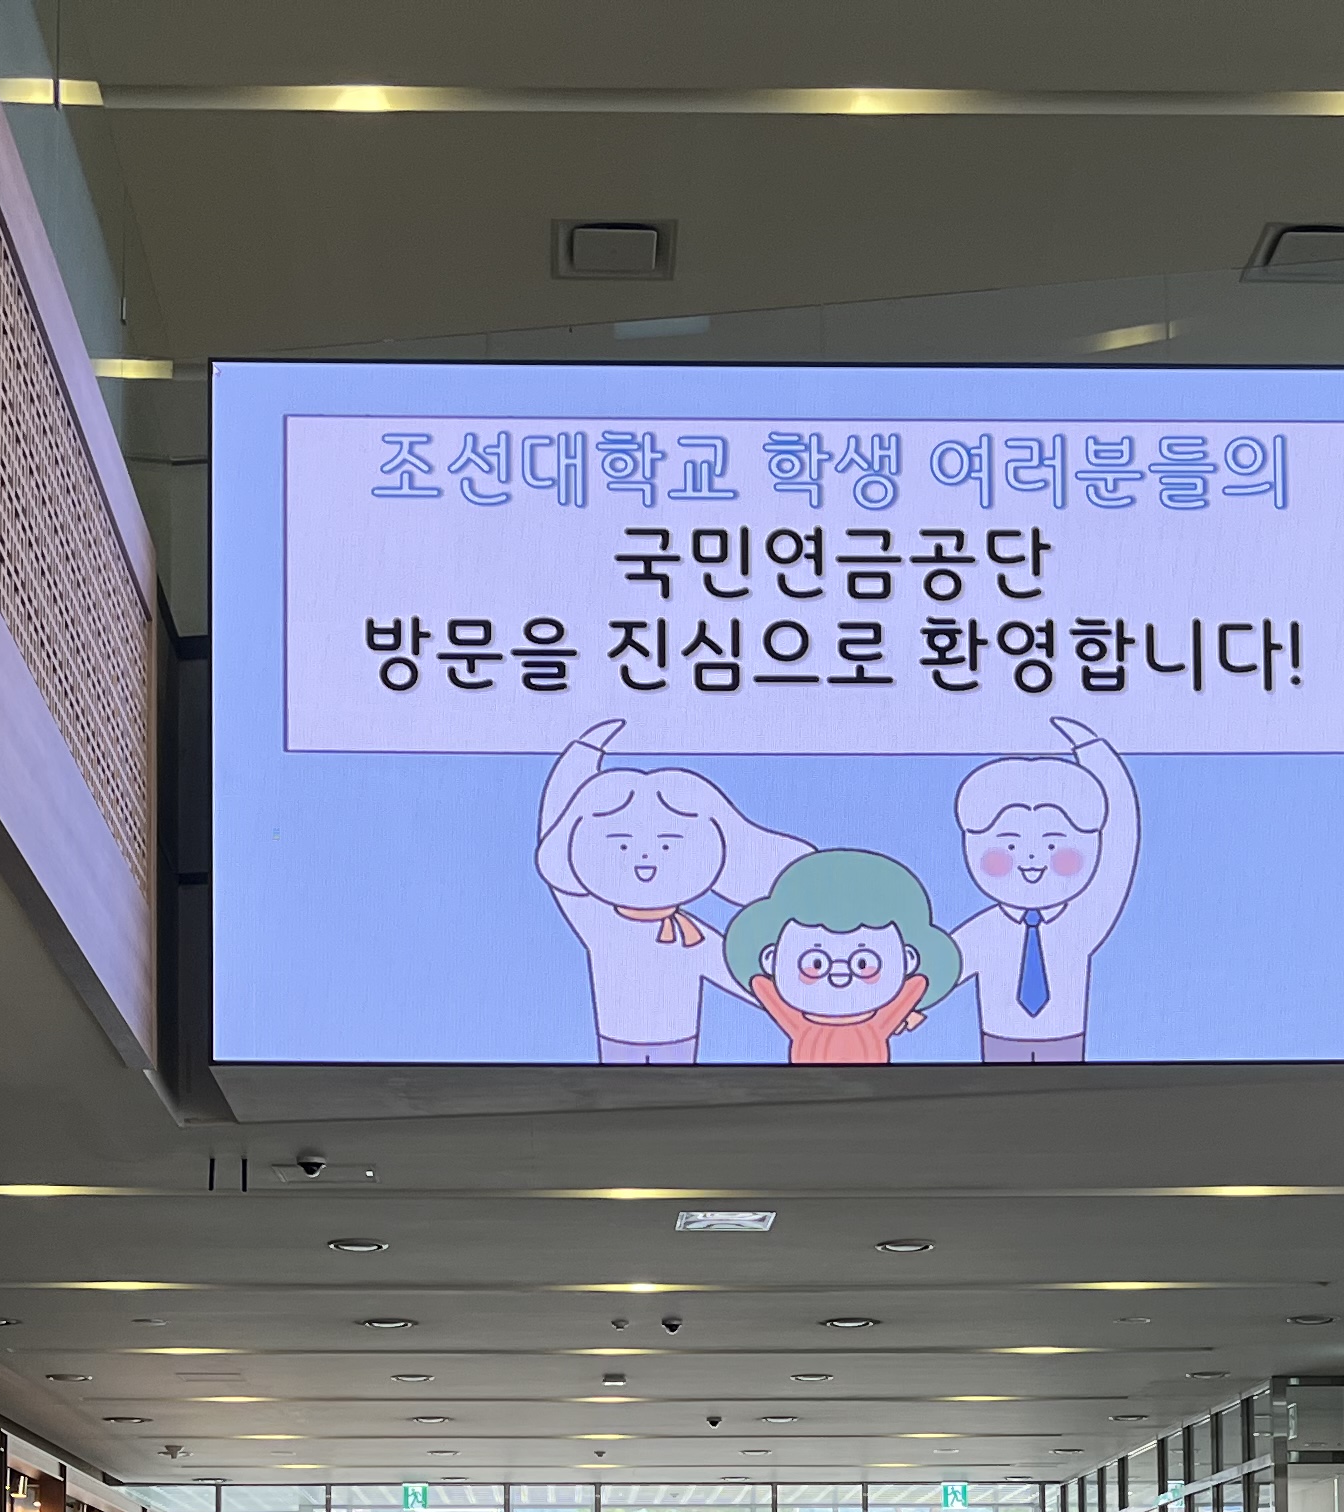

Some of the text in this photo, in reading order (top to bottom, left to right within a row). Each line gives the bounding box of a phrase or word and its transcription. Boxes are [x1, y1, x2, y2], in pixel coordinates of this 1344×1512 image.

[369, 430, 1292, 511] 조선대학교 학생 여러분들의
[613, 525, 1055, 600] 국민연금공단
[363, 615, 1305, 694] 방문을 진심으로 환영합니다!
